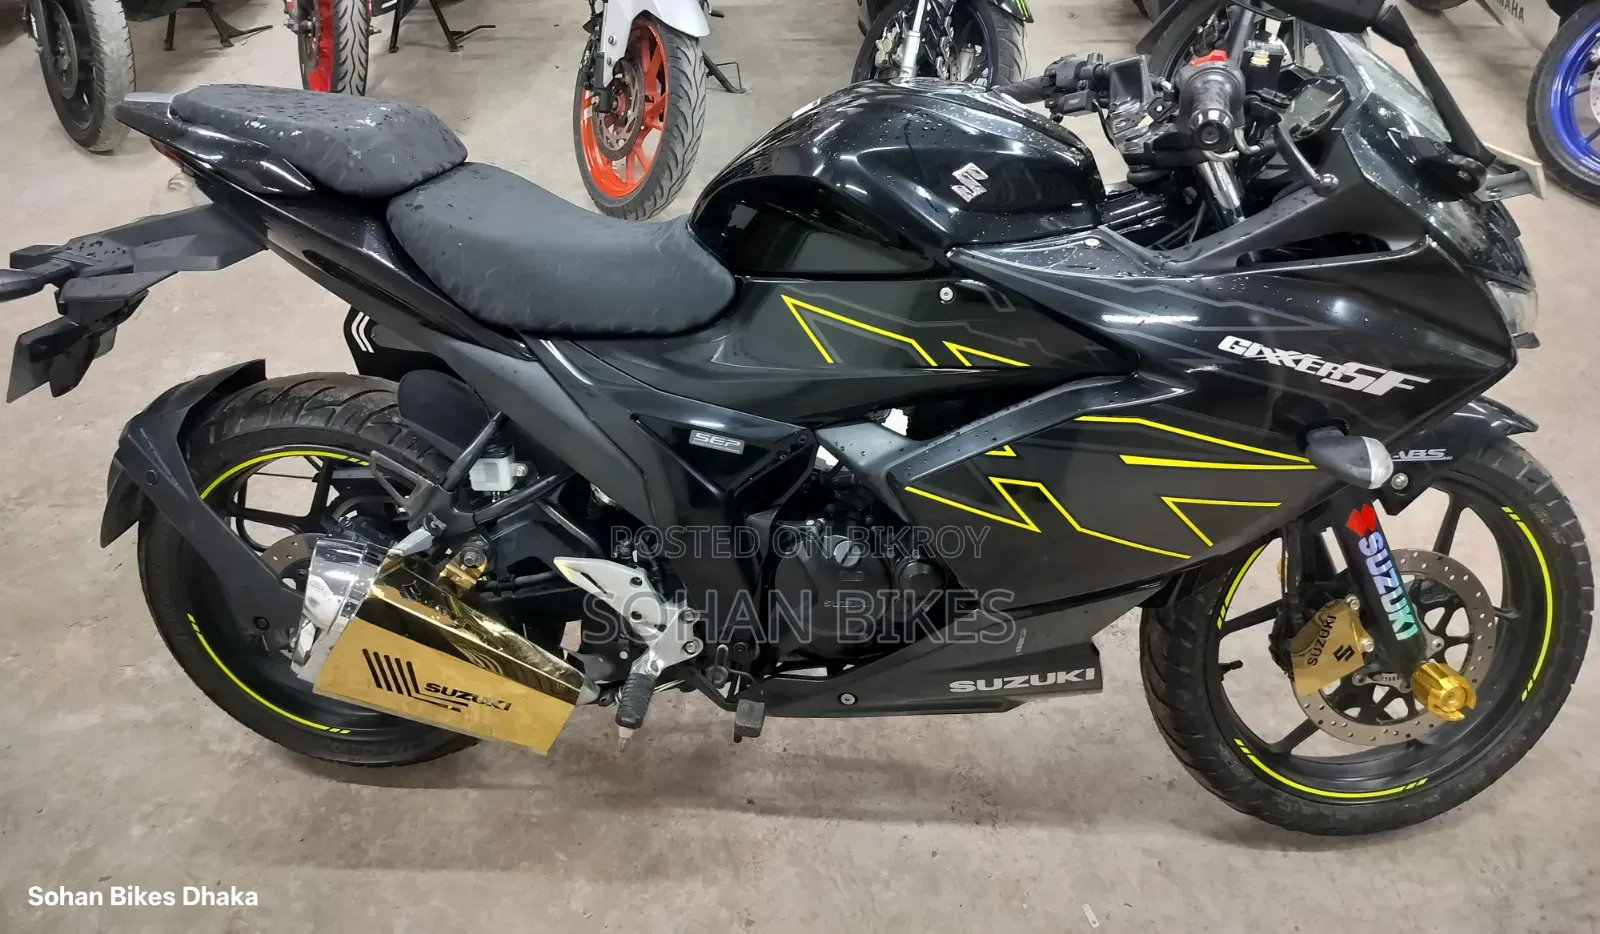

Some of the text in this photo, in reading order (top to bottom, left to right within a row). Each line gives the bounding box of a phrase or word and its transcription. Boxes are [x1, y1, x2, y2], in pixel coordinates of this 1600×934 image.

[693, 432, 741, 447] SEP
[1358, 531, 1419, 641] SUZUKI
[1307, 615, 1337, 667] SUZUKI
[949, 667, 1096, 693] SUZUKI
[424, 682, 512, 712] SUZUKI
